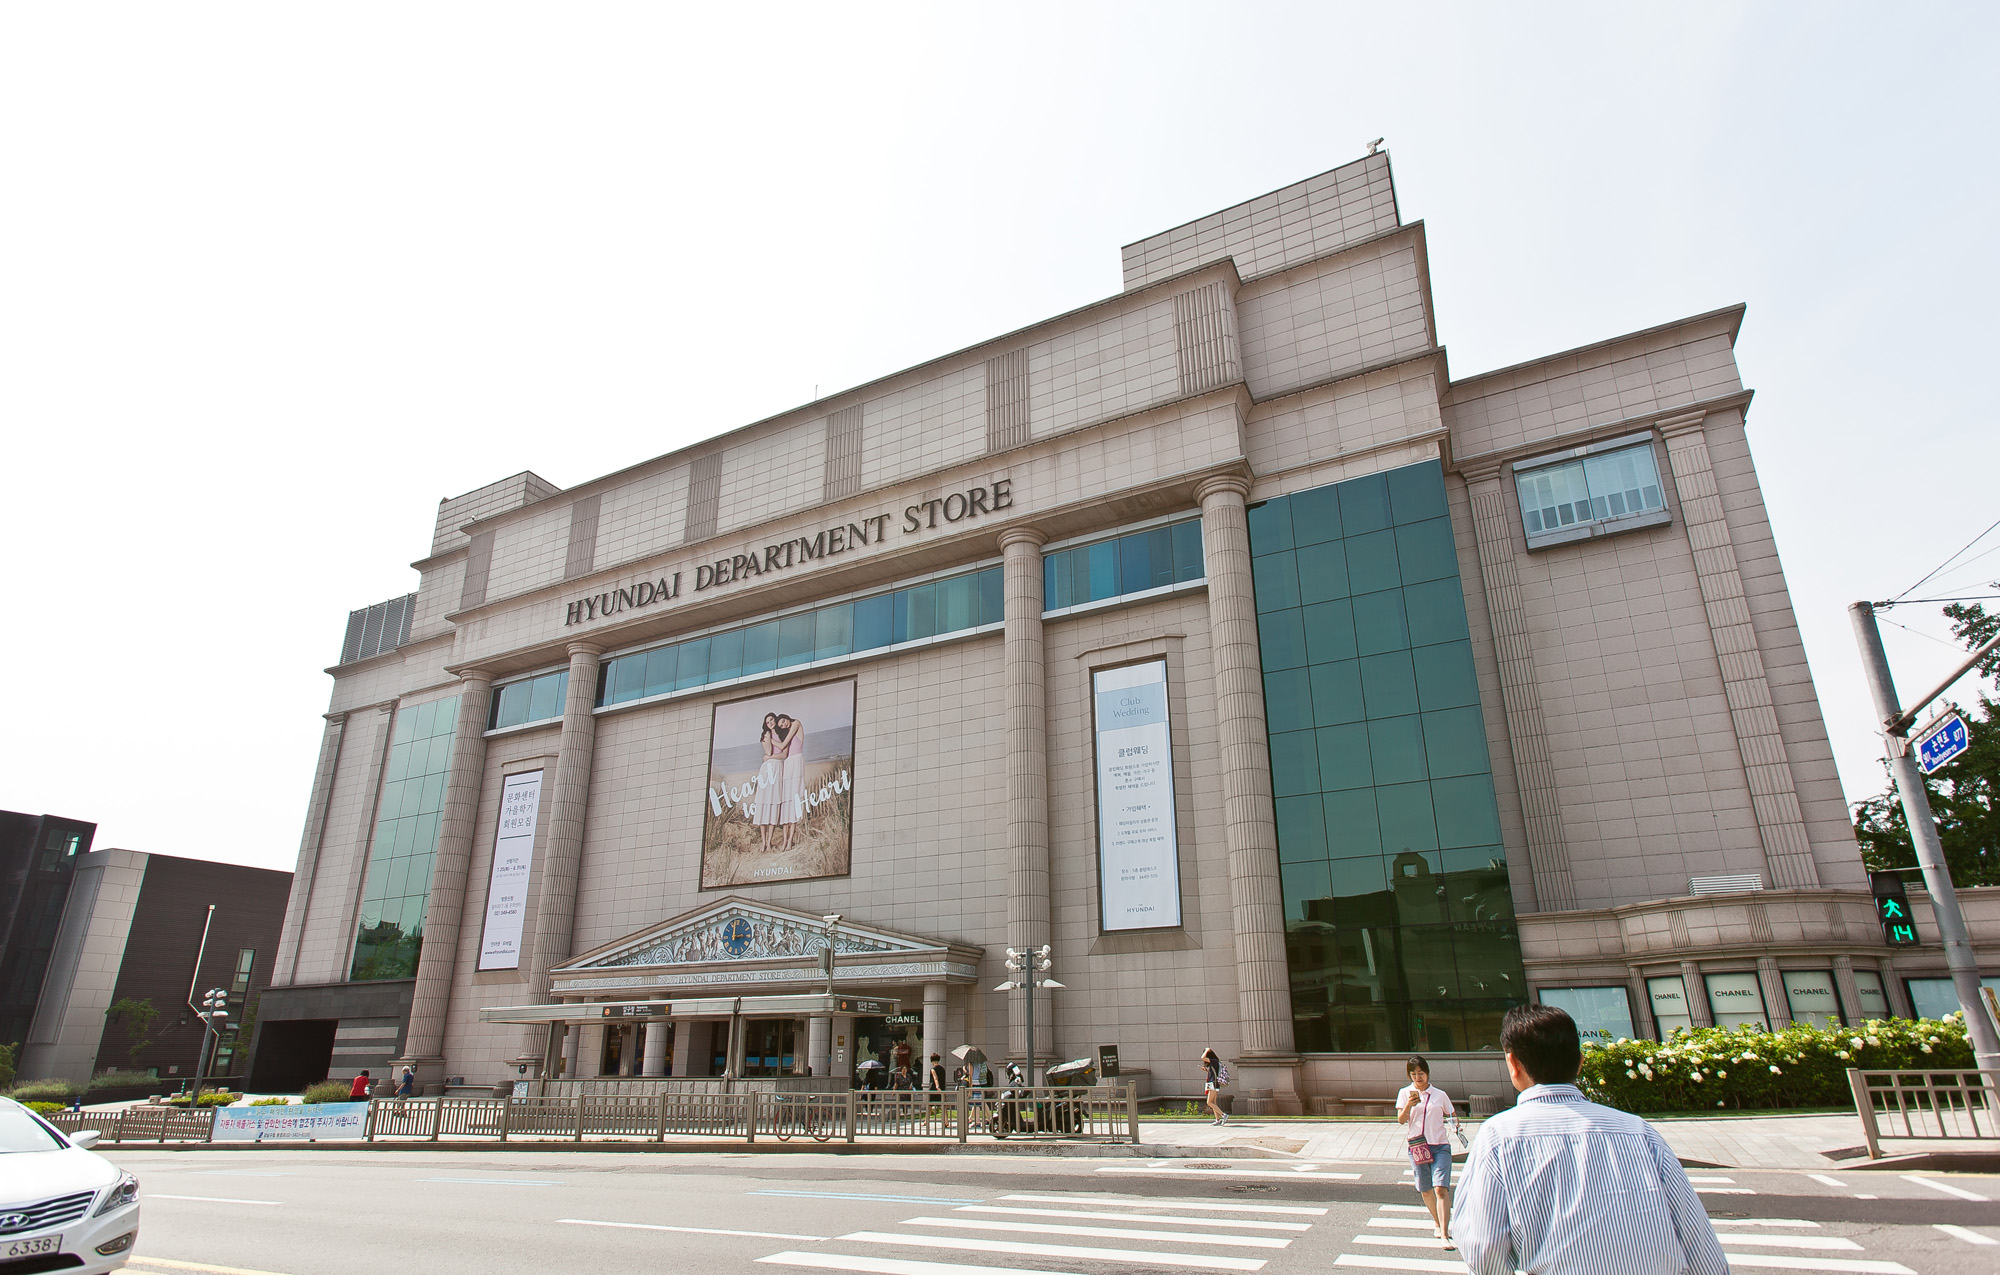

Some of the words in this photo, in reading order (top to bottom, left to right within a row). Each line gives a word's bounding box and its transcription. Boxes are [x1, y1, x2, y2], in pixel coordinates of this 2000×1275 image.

[564, 571, 681, 626] HYUNDAI
[694, 514, 890, 592] DEPARTMENT
[902, 478, 1014, 534] STORE
[1120, 697, 1140, 706] Club
[1112, 706, 1150, 718] Wedding
[1930, 730, 1950, 752] 논현로
[1952, 726, 1964, 742] 877
[1118, 745, 1148, 758] 클럽웨딩
[507, 790, 536, 804] 문화센터
[709, 763, 778, 817] Heart
[794, 770, 852, 818] Heart
[505, 802, 534, 816] 가을학기
[742, 802, 757, 818] to
[503, 816, 532, 829] 회원모집
[754, 866, 792, 877] HYUNDAI
[1893, 924, 1913, 942] 14
[679, 974, 708, 984] HYUNDAI
[712, 973, 756, 982] DEPARTMENT
[760, 972, 781, 980] STORE
[885, 1016, 920, 1024] CHANEL
[220, 1119, 235, 1129] 자동차
[236, 1118, 256, 1129] 배출가스
[265, 1118, 280, 1129] 공회전
[317, 1117, 334, 1128] 주시기
[9, 1238, 52, 1256] 6338
